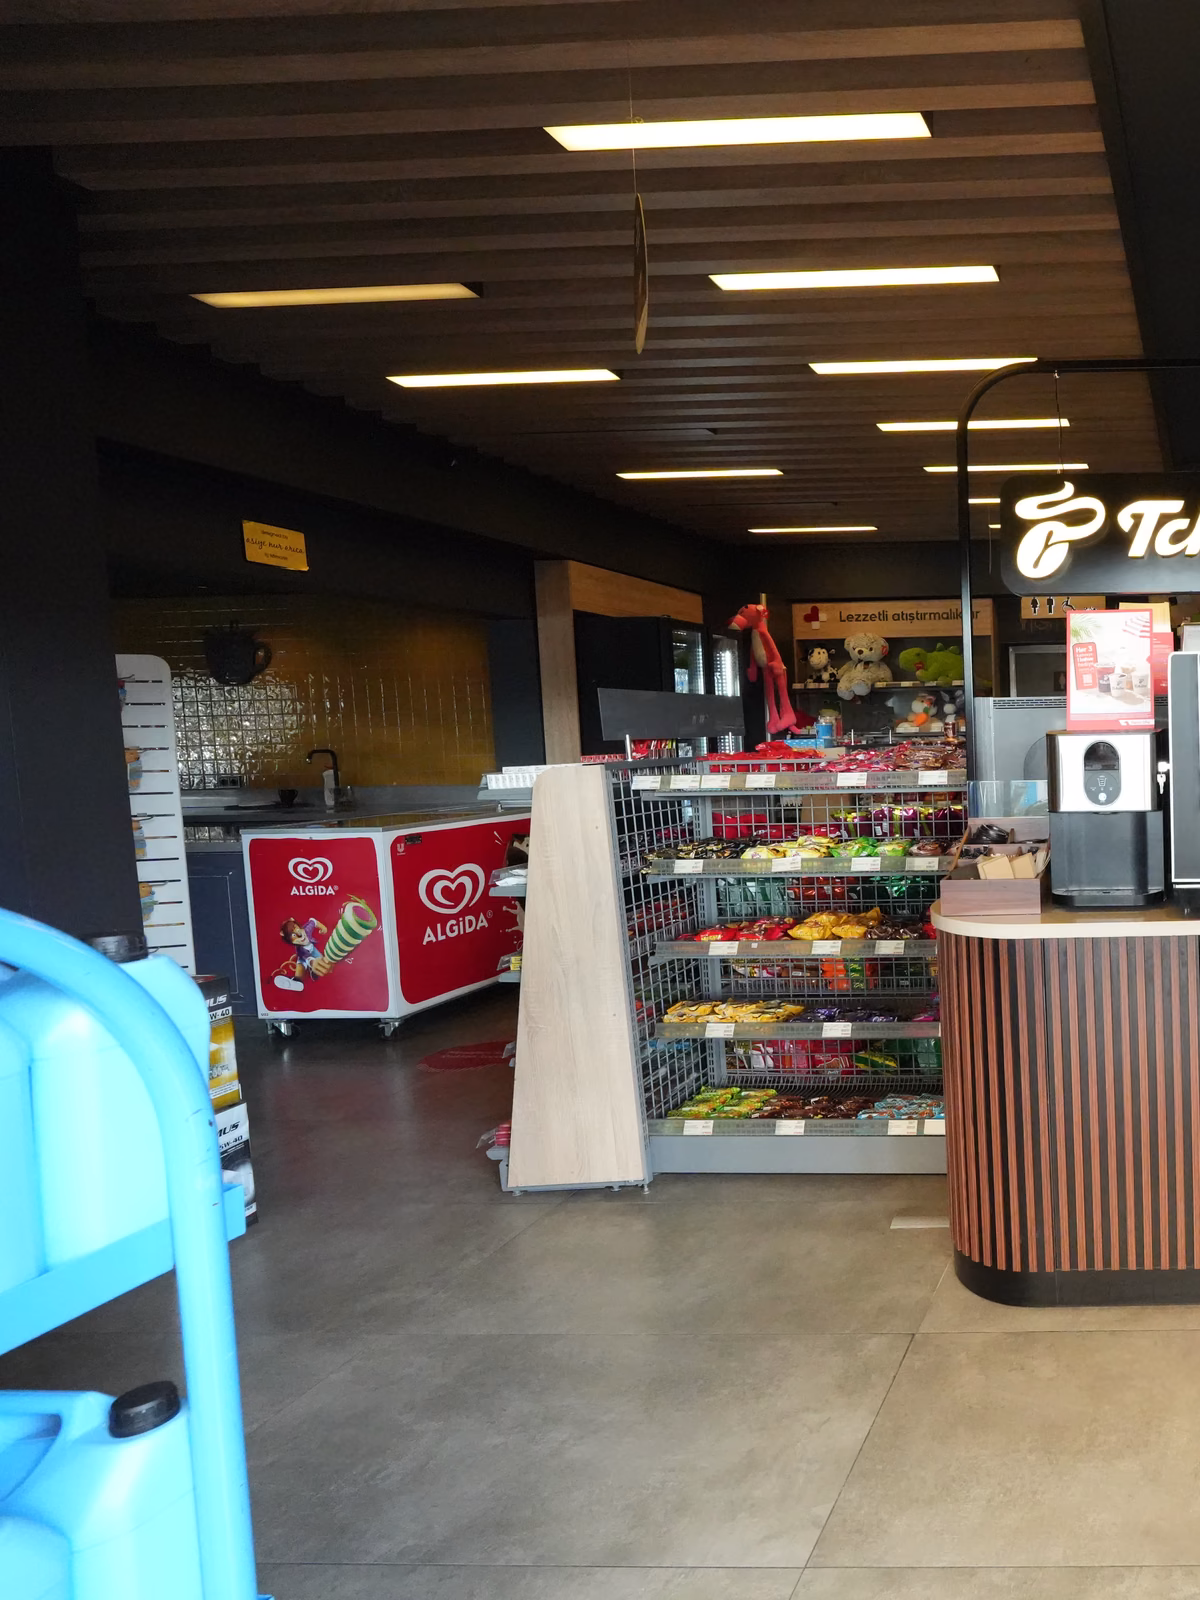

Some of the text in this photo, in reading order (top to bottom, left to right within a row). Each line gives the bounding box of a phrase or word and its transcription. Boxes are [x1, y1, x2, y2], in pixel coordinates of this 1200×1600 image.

[839, 608, 981, 624] Lezzetli atıştırmalıkr
[209, 1008, 230, 1021] W-40
